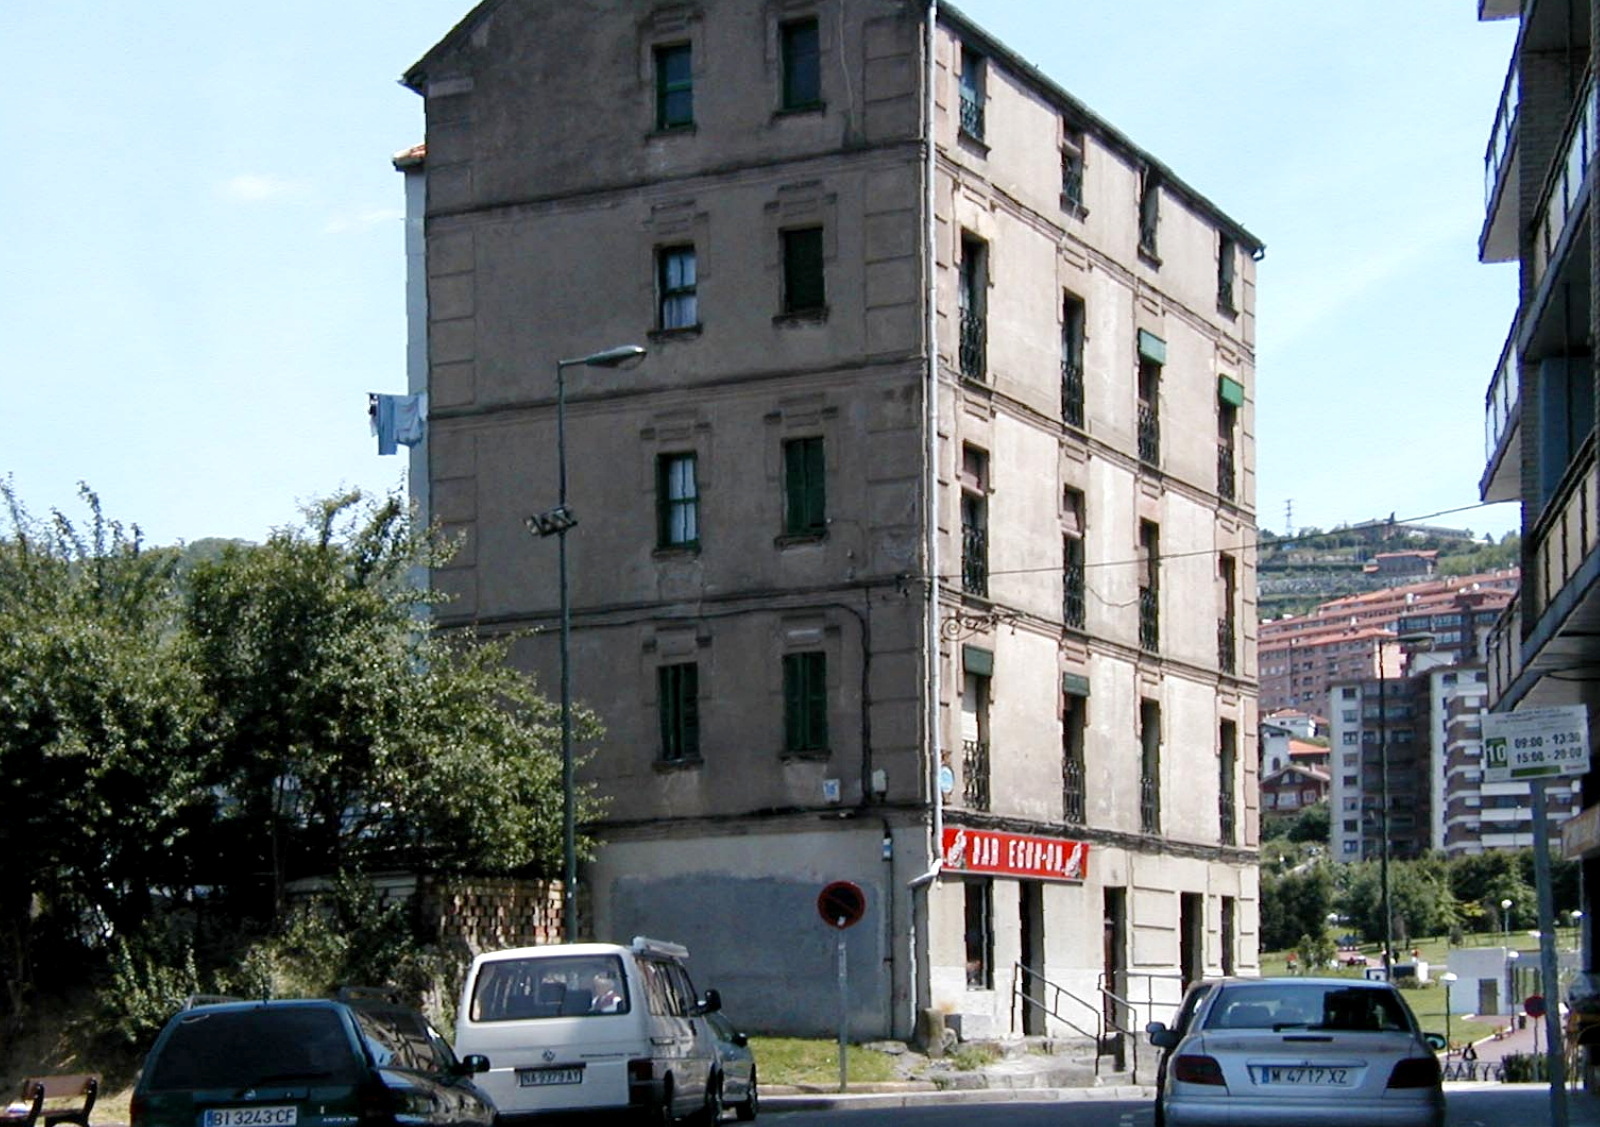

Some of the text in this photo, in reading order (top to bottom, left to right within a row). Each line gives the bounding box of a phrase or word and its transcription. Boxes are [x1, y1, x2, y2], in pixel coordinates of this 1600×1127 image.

[1487, 744, 1506, 762] 10
[972, 836, 999, 865] BAR
[233, 1110, 272, 1125] 3243
[276, 1108, 297, 1123] CF
